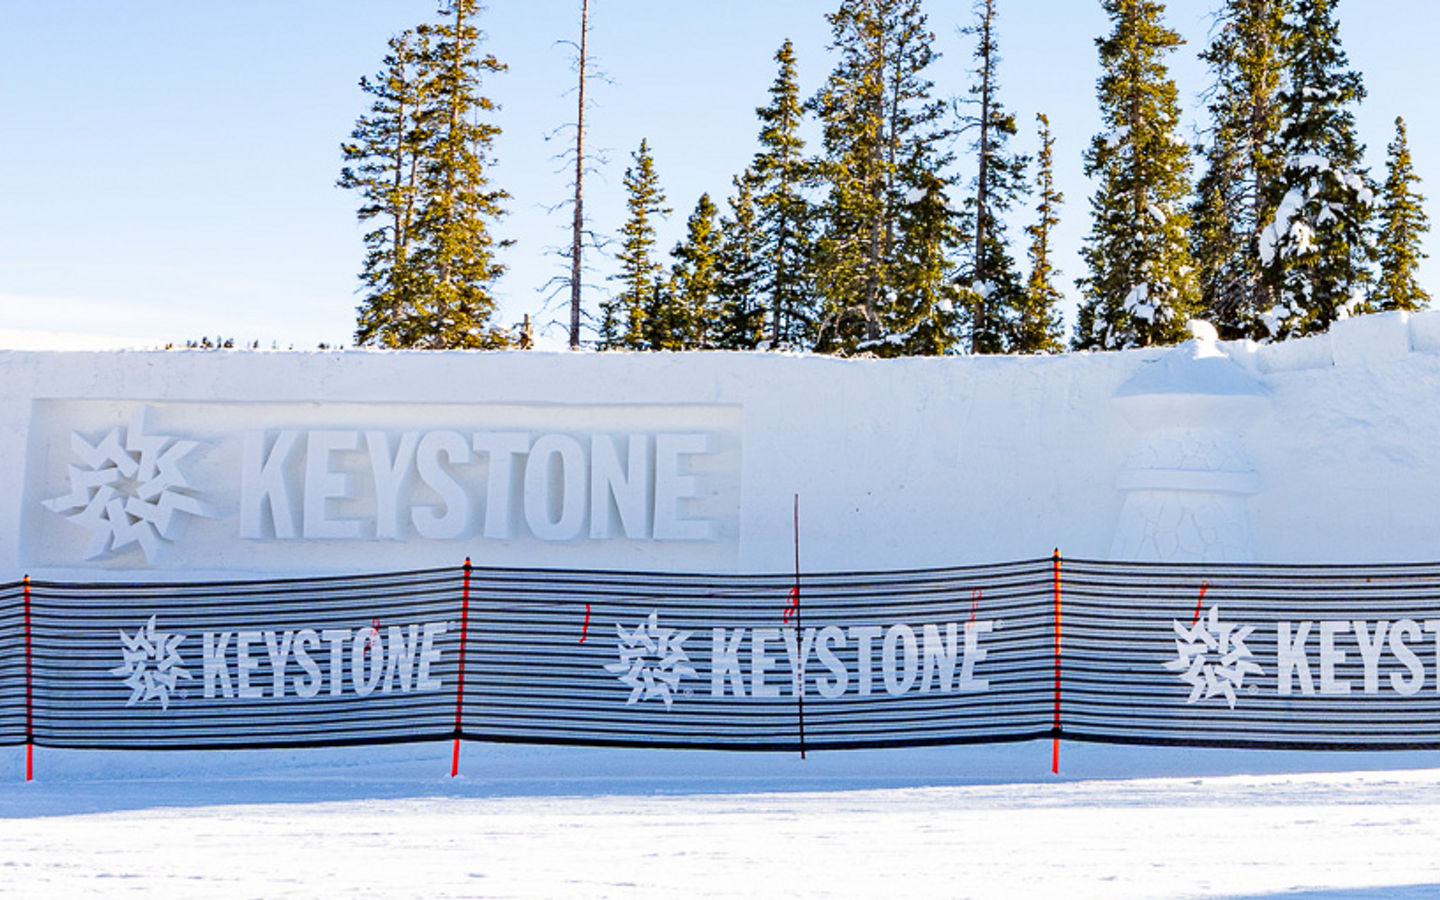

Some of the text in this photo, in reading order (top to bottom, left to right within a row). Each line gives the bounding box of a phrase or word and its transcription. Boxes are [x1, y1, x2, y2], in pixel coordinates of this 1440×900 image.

[240, 429, 709, 541] KEYSTONE
[203, 622, 446, 699] KEYSTONE
[711, 620, 994, 698] KEYSTONE
